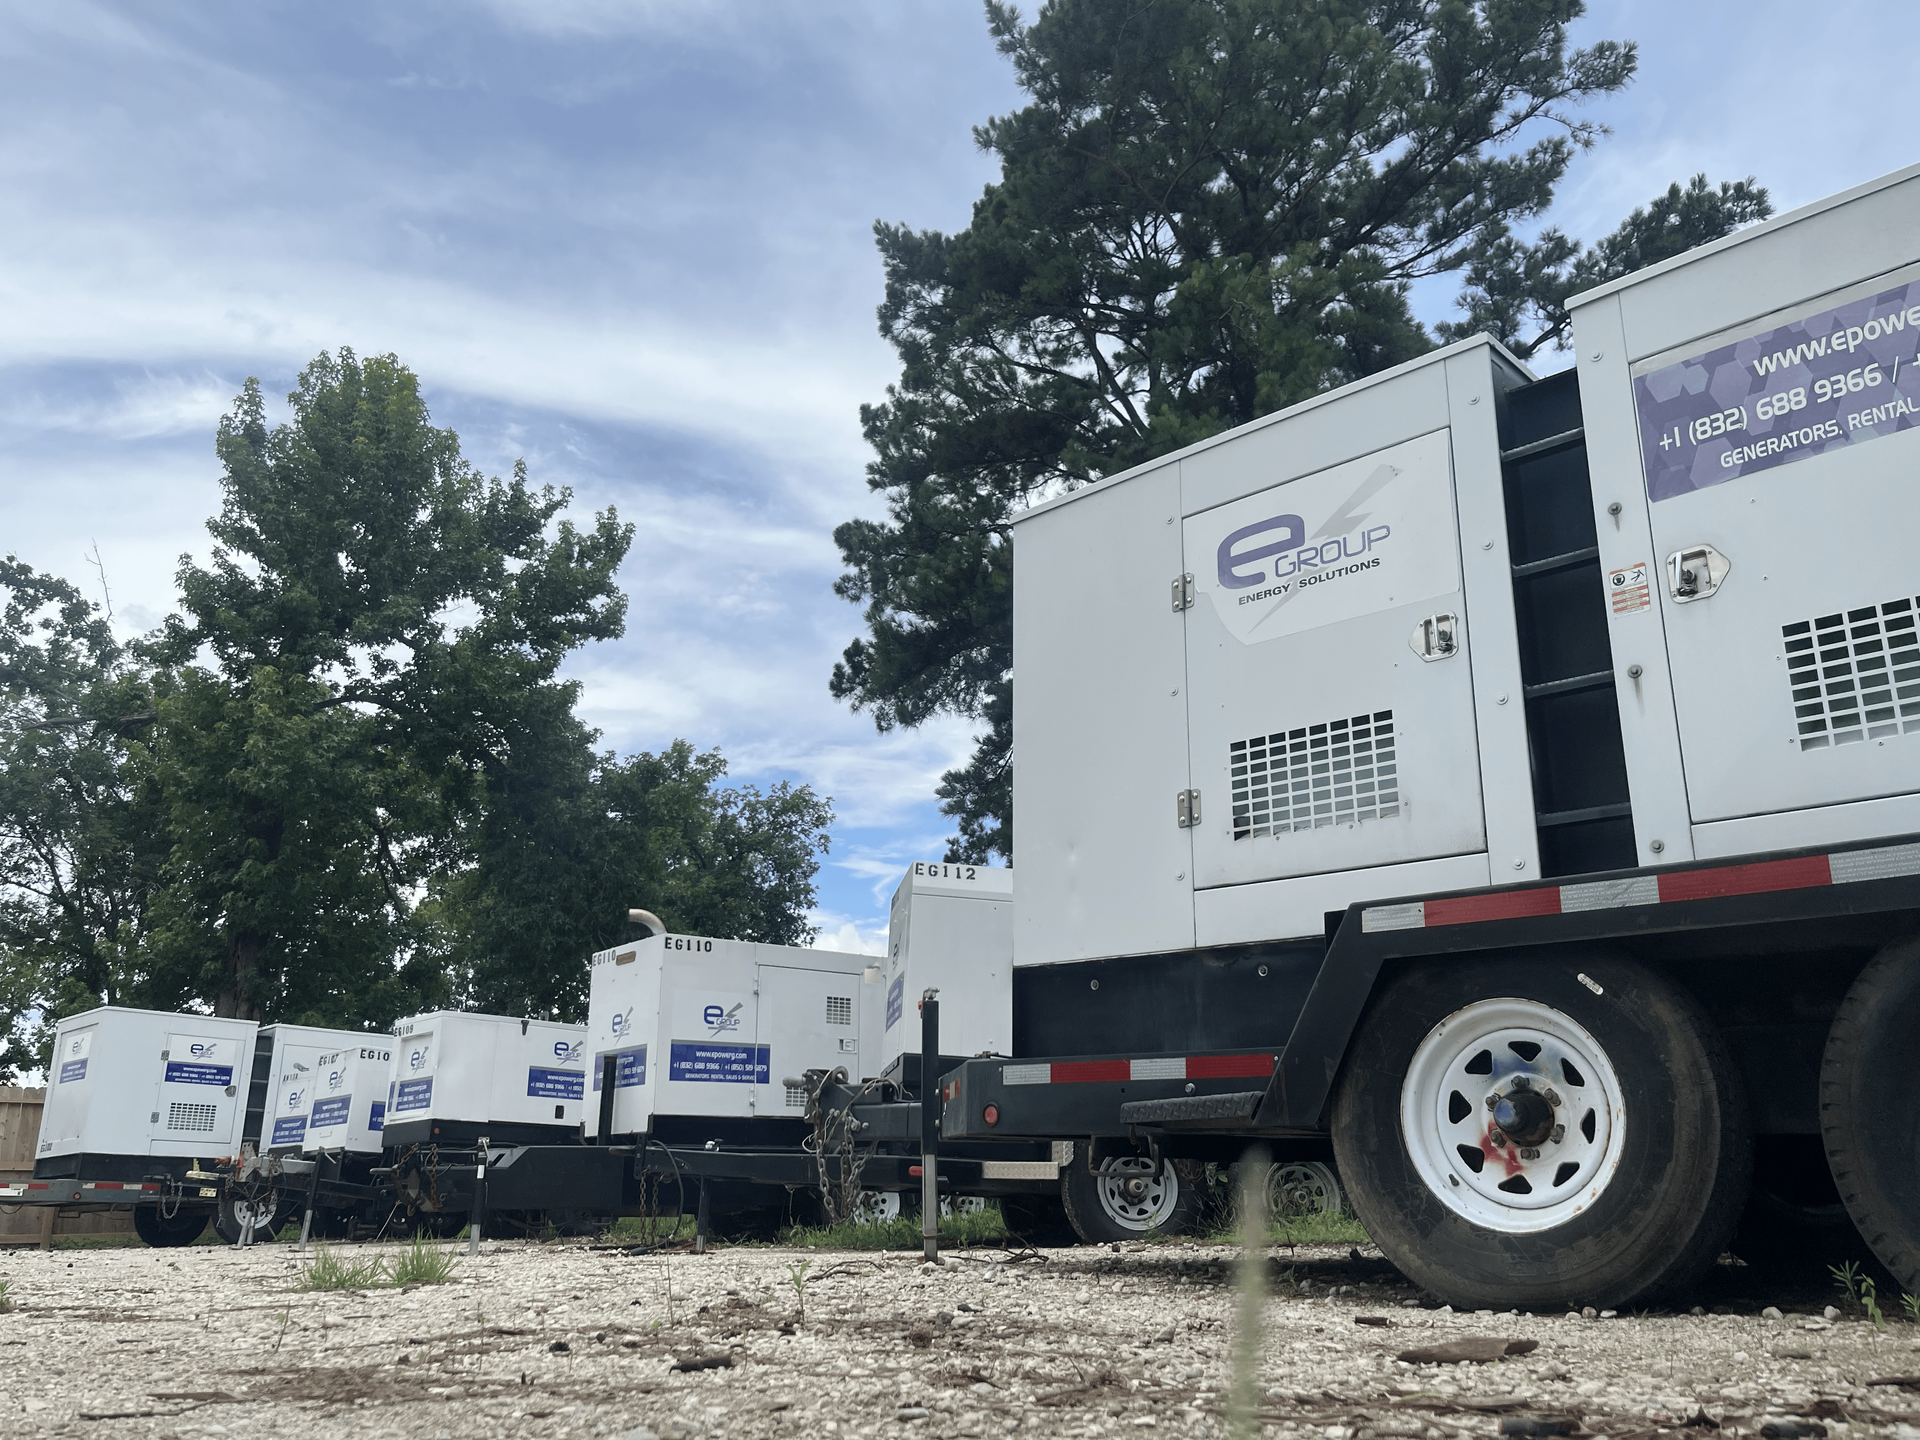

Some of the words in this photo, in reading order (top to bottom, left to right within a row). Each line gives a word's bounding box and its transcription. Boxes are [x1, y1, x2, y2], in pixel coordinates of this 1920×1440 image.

[1659, 426, 1681, 451] +1
[1689, 406, 1748, 445] (832)
[1756, 387, 1807, 420] 688
[1814, 362, 1882, 403] 9366
[1720, 420, 1843, 468] GENERATORS,
[1848, 397, 1920, 431] RENTAL
[1275, 525, 1391, 578] GROUP
[1238, 583, 1291, 606] ENERGY
[1298, 558, 1381, 588] SOLUTIONS
[915, 862, 976, 880] EG112
[592, 949, 616, 967] EG110
[664, 936, 712, 953] EG110
[360, 1048, 390, 1062] EG10
